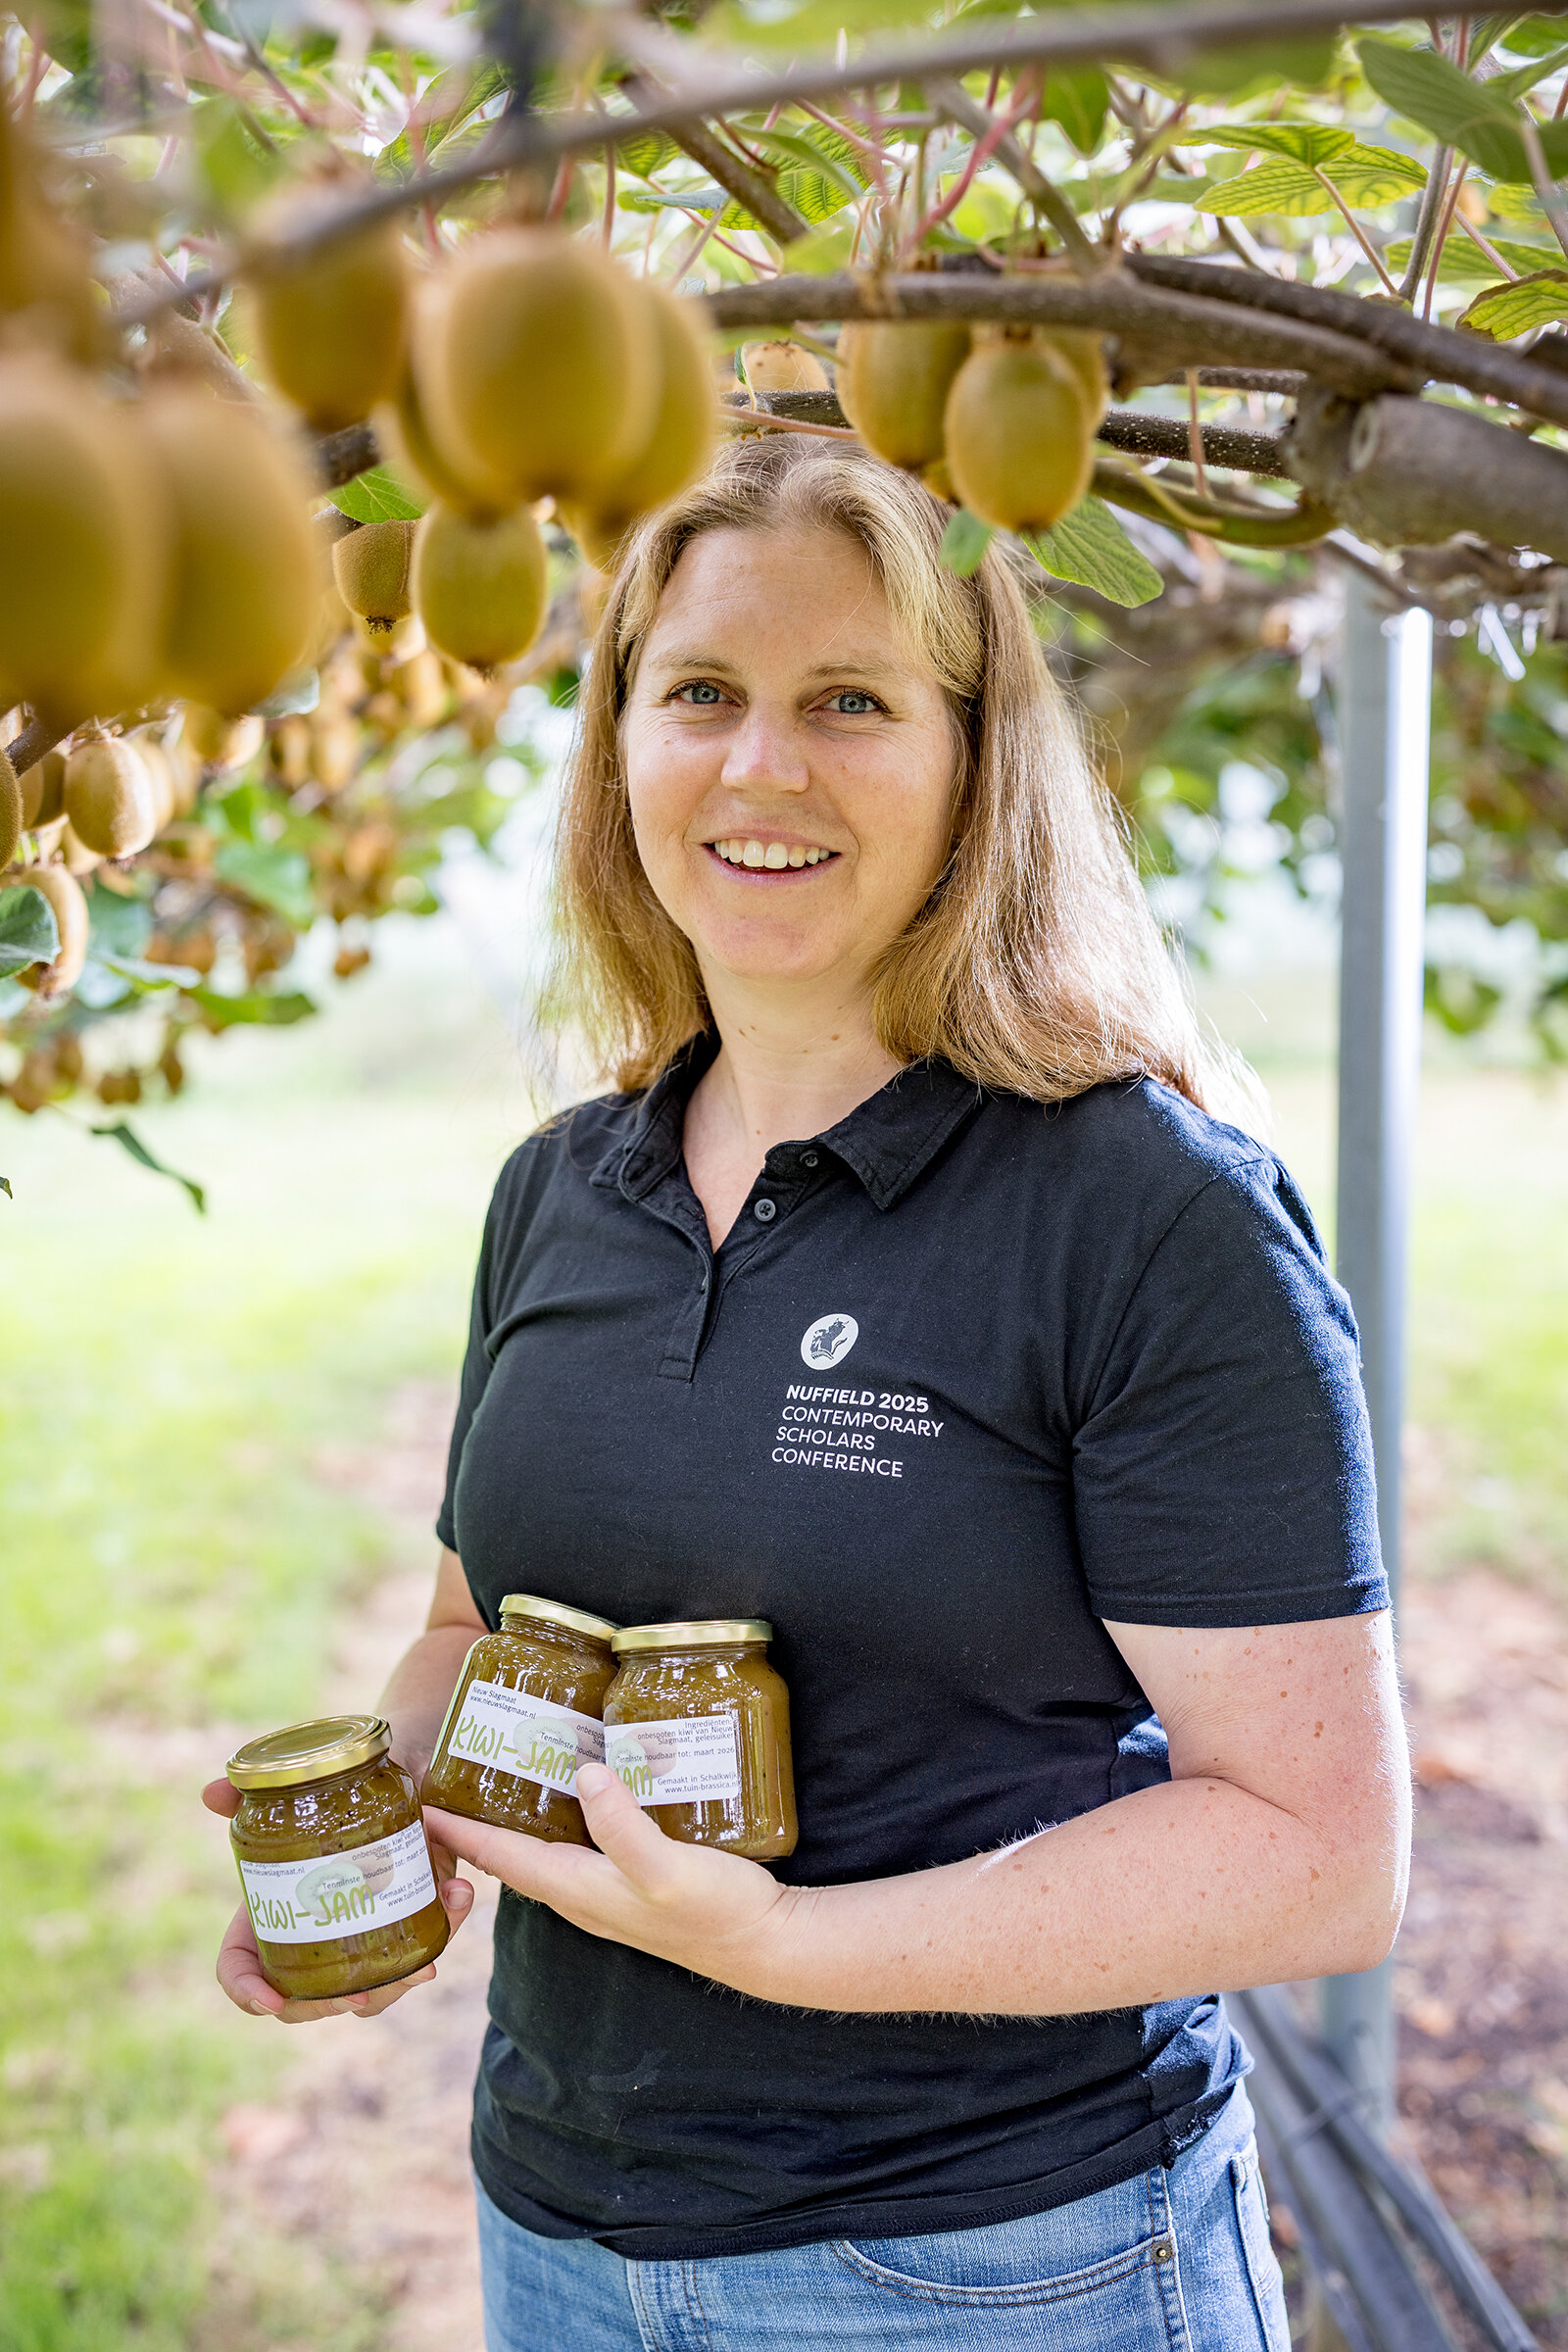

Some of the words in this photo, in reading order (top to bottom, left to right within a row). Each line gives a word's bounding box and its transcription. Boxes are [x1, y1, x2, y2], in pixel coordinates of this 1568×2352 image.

[786, 1384, 875, 1406] NUFFIELD
[878, 1393, 929, 1413] 2025
[782, 1405, 945, 1438] CONTEMPORARY
[776, 1426, 876, 1450] SCHOLARS
[771, 1447, 904, 1478] CONFERENCE
[469, 1694, 537, 1719] www.nieuwslagmaat.nl
[472, 1686, 488, 1695] Nieuw
[489, 1690, 517, 1704] Slagmaat
[637, 1731, 676, 1741] onbespoten
[684, 1719, 733, 1730] Ingrediënten:
[453, 1715, 577, 1785] KIWI-JAM
[540, 1732, 574, 1750] Tenminste
[574, 1744, 601, 1761] houdbaar
[658, 1737, 694, 1746] Slagmaat,
[695, 1733, 734, 1743] geleisuiker
[645, 1752, 676, 1761] houdbaar
[658, 1777, 688, 1786] Gemaakt
[352, 1842, 392, 1861] onbespoten
[322, 1876, 361, 1890] Tenminste
[363, 1863, 394, 1880] houdbaar
[395, 1859, 406, 1868] tot:
[378, 1885, 407, 1900] Gemaakt
[250, 1885, 376, 1930] KIWI-JAM
